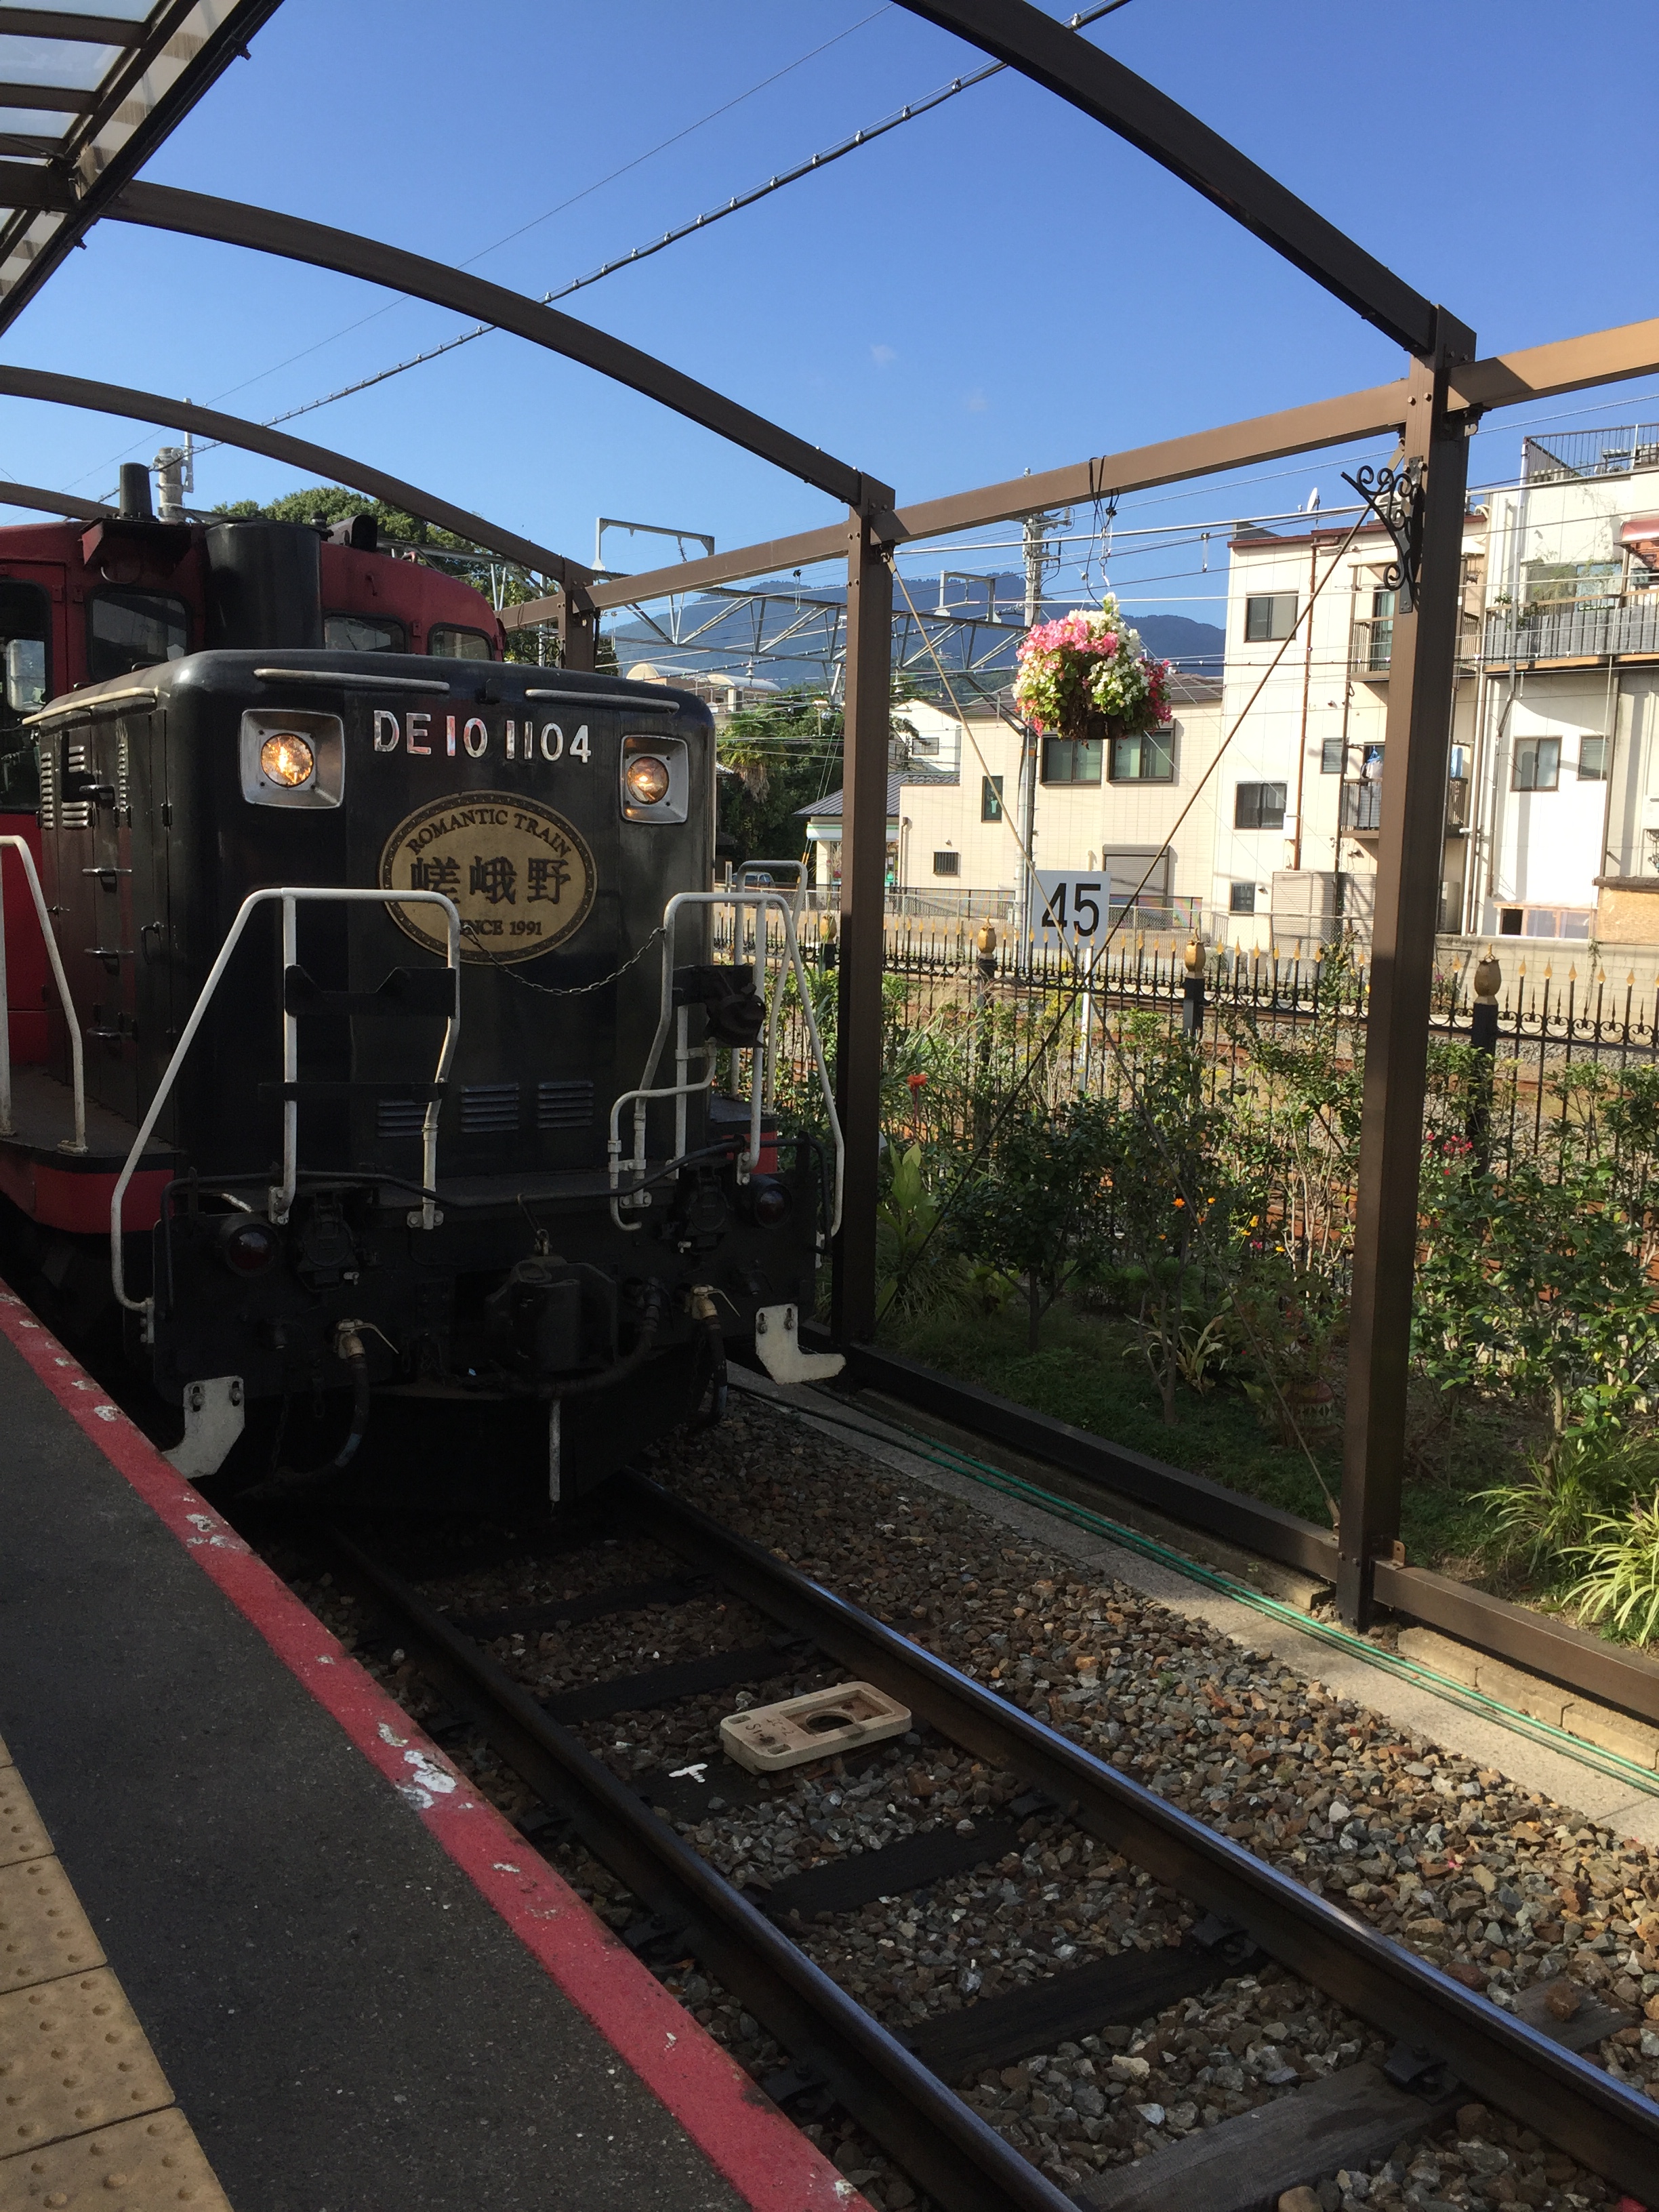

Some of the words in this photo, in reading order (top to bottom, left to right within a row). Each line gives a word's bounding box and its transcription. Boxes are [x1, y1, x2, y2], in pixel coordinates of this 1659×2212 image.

[506, 720, 592, 763] 1104
[405, 808, 508, 855] ROMANTIC
[514, 813, 571, 857] TRAIN
[509, 920, 543, 936] 1991
[1041, 882, 1101, 937] 45
